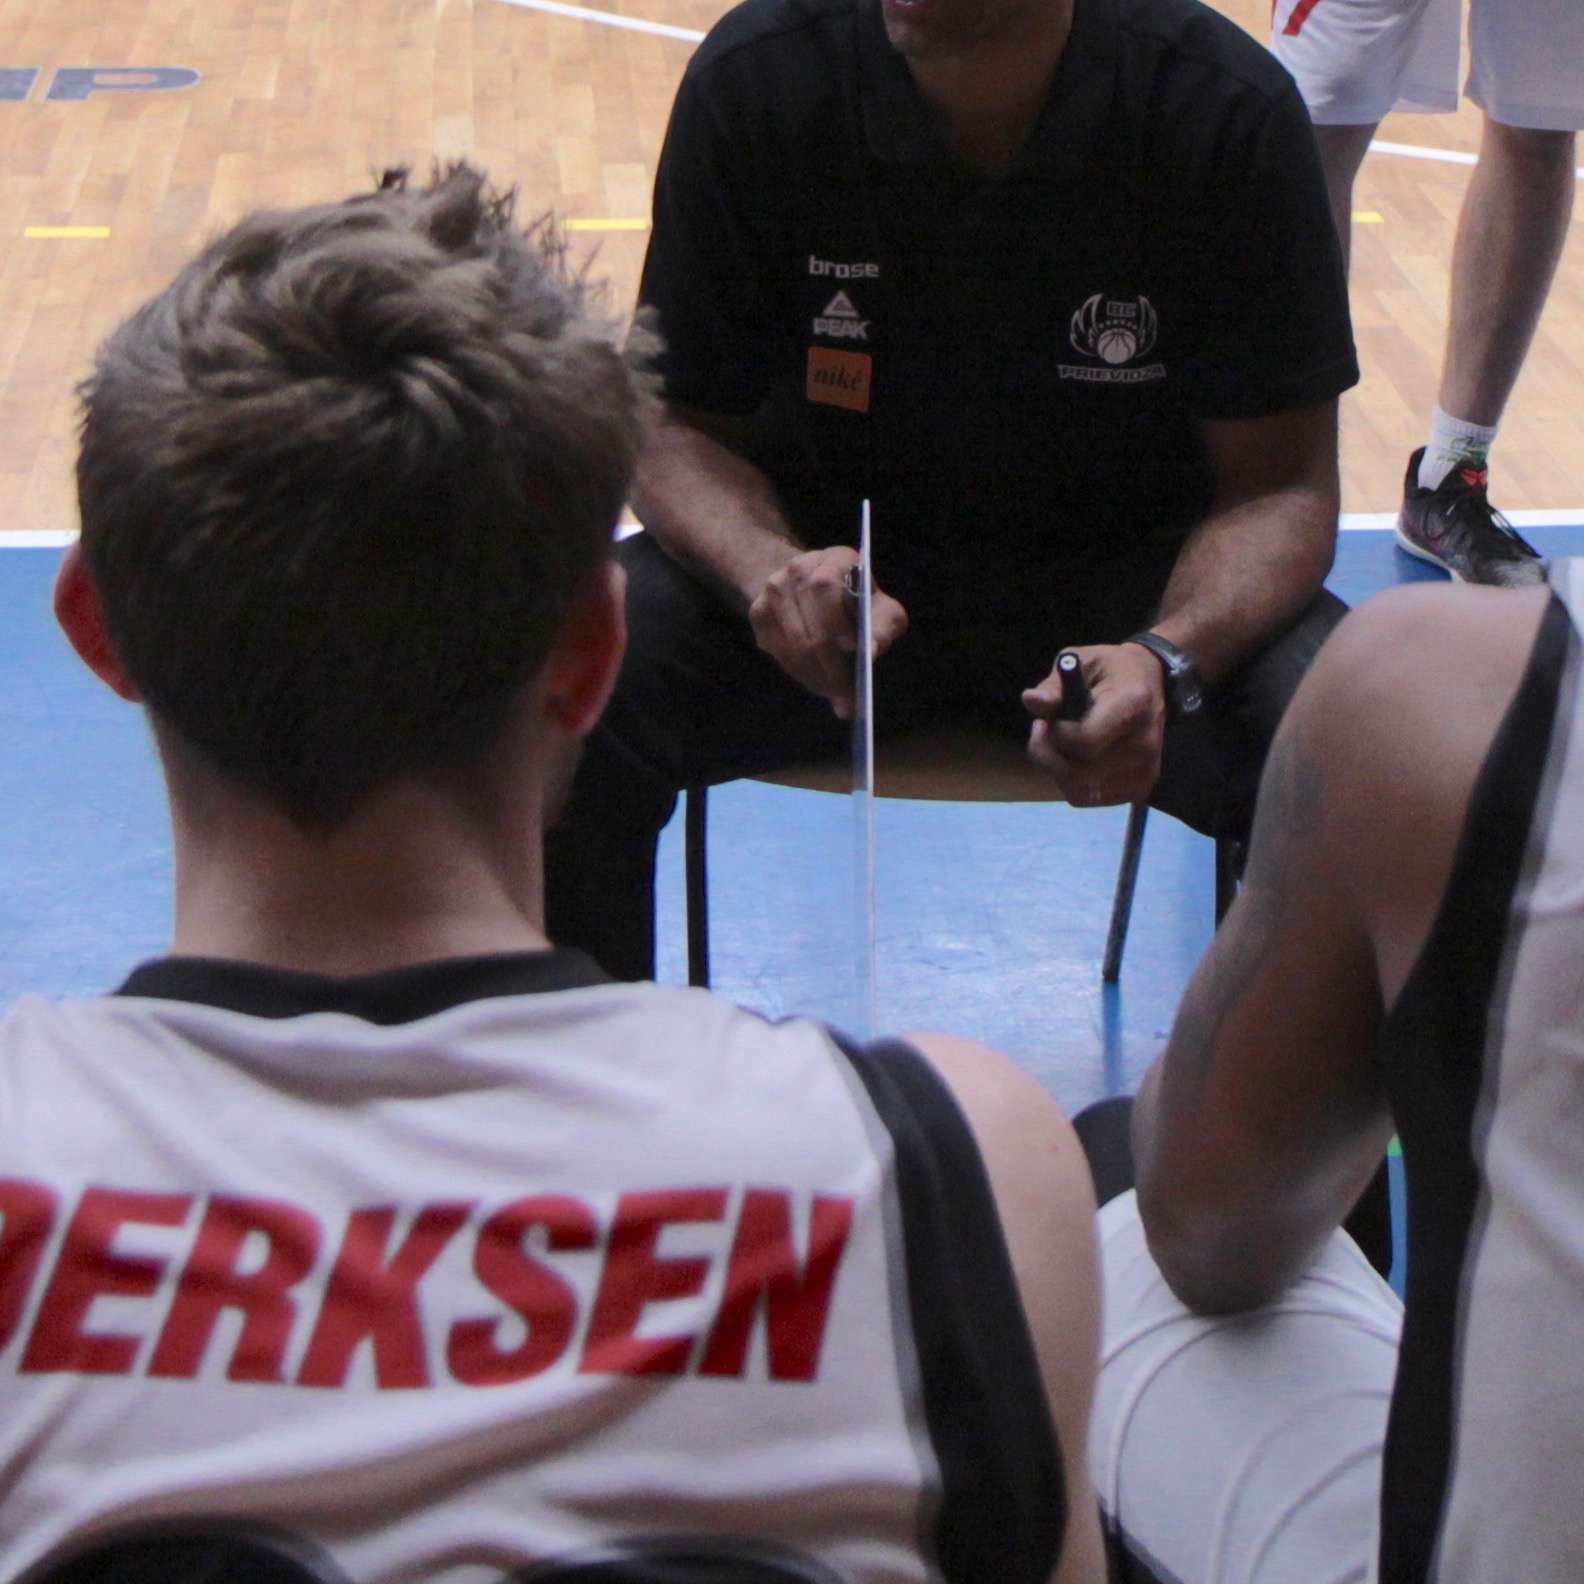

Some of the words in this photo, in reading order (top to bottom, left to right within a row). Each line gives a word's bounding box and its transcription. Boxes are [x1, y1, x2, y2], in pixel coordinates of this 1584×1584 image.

[807, 254, 881, 279] brose
[812, 316, 872, 341] PEAK
[813, 365, 863, 392] niké
[1057, 362, 1167, 384] PRIEVIDZA
